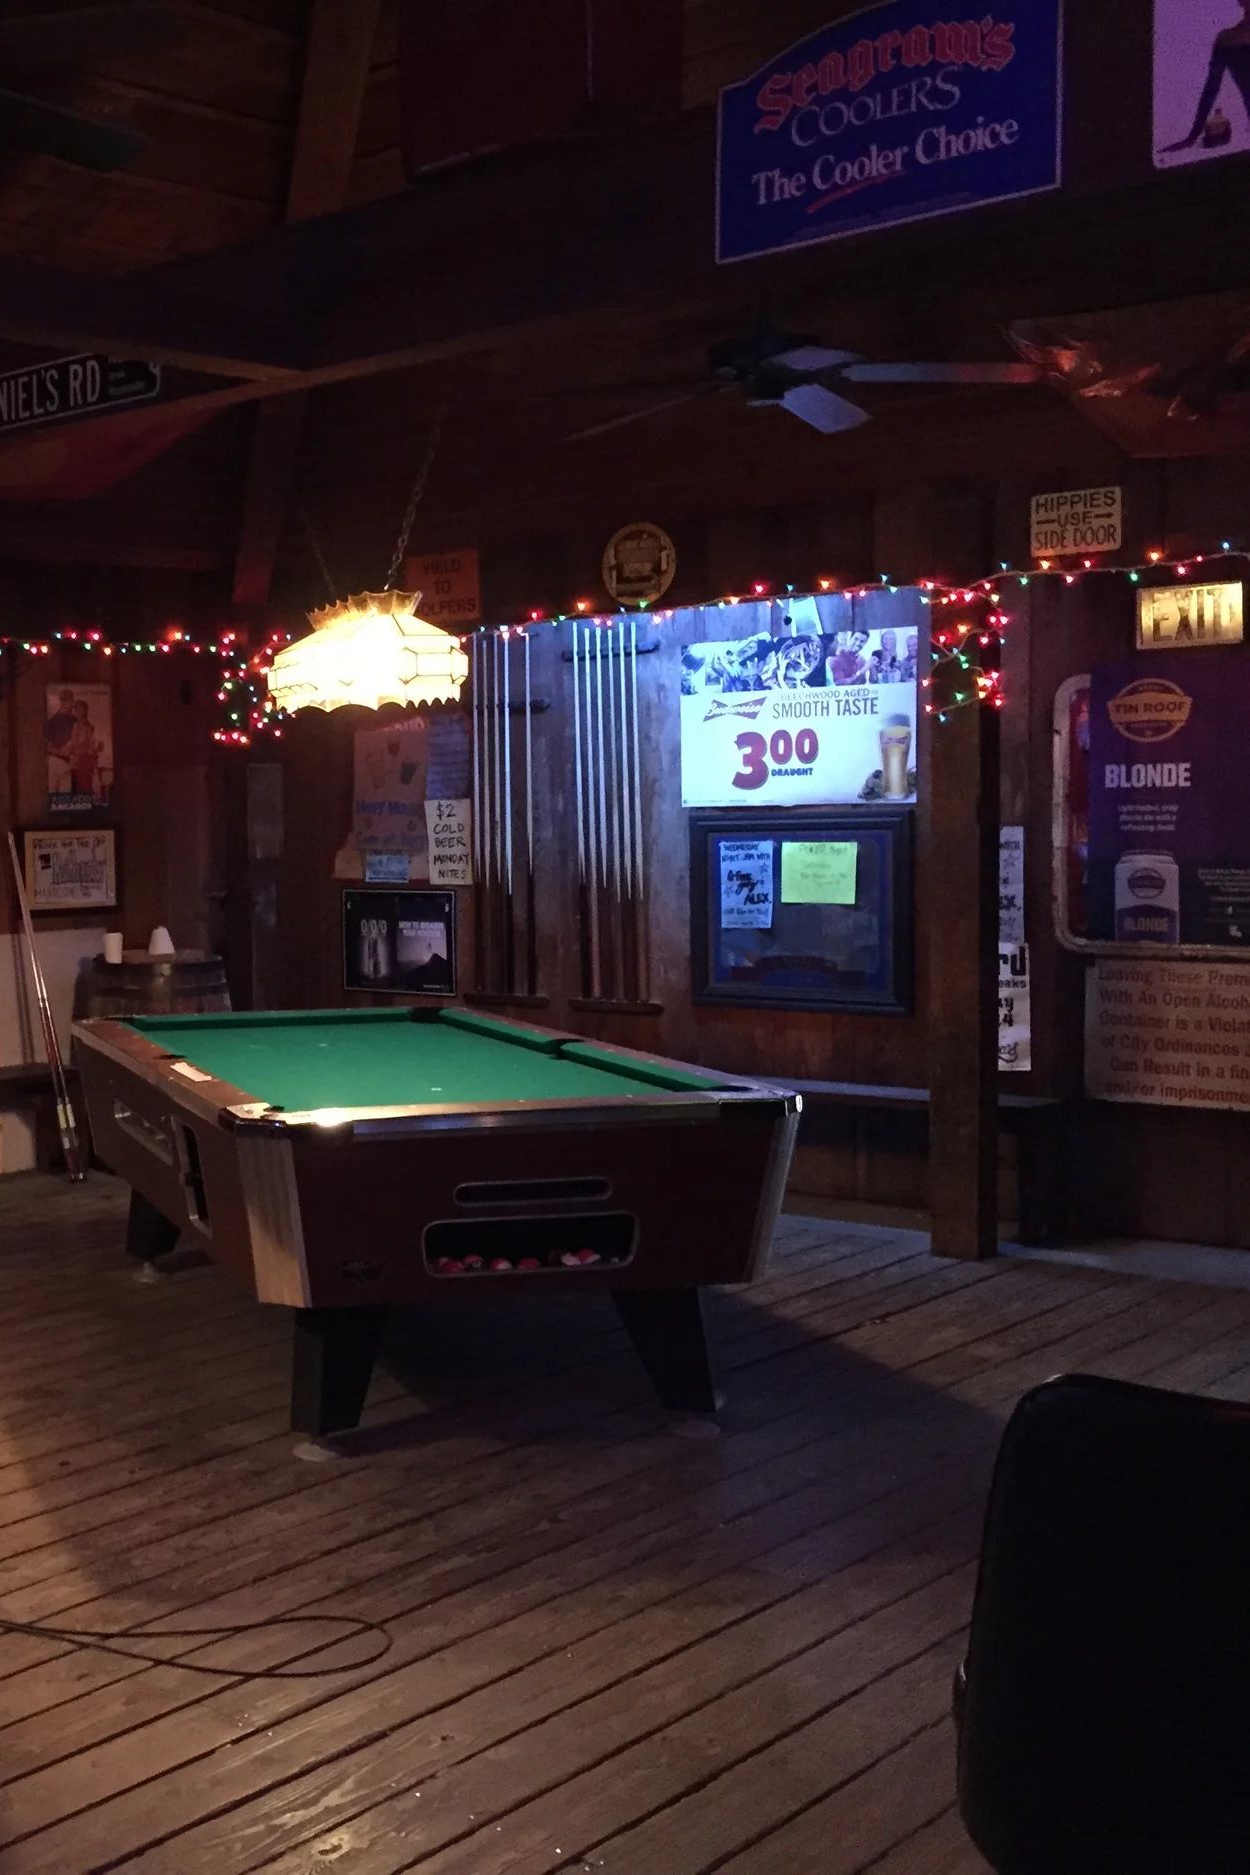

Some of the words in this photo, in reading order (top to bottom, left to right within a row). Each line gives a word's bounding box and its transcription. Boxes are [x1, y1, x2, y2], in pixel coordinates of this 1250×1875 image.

[754, 14, 1015, 134] Seagram's
[791, 66, 964, 147] COOLERS
[751, 168, 807, 206] The
[813, 143, 910, 190] Cooler
[915, 116, 1019, 165] Choice
[68, 359, 100, 407] RD
[1035, 489, 1116, 515] HIPPIES
[1057, 511, 1094, 527] USE
[1035, 529, 1067, 550] SIDE
[1073, 523, 1117, 547] DOOR
[423, 559, 461, 574] YIELD
[432, 580, 451, 594] TO
[421, 597, 476, 616] OLFERS
[1152, 589, 1226, 642] EXIT
[781, 690, 840, 701] BEECHWOOD
[844, 688, 870, 698] AGED
[772, 701, 830, 720] SMOOTH
[835, 697, 879, 716] TASTE
[1115, 703, 1138, 714] TIN
[1143, 701, 1186, 713] ROOF
[731, 731, 770, 791] 3
[771, 768, 814, 777] DRAUGHT
[1105, 762, 1191, 788] BLONDE
[437, 801, 456, 820] $2
[433, 823, 465, 834] COLD
[435, 836, 466, 848] BEER
[433, 853, 469, 865] MONDAY
[438, 869, 466, 879] NITES
[1124, 916, 1169, 931] BLONDE
[1099, 966, 1153, 985] Leaving
[1160, 968, 1203, 984] These
[1099, 989, 1132, 1004] With
[1139, 991, 1157, 1006] An
[1163, 992, 1201, 1008] Open
[1207, 994, 1250, 1010] Alcoh
[1099, 1010, 1170, 1029] Container
[1177, 1017, 1188, 1031] is
[1194, 1020, 1203, 1031] a
[1102, 1035, 1116, 1048] of
[1120, 1034, 1149, 1052] City
[1154, 1037, 1239, 1056] Ordinances
[1111, 1057, 1138, 1072] Can
[1144, 1060, 1191, 1077] Result
[1197, 1063, 1210, 1077] in
[1216, 1068, 1225, 1079] a
[1104, 1082, 1155, 1098] and/or
